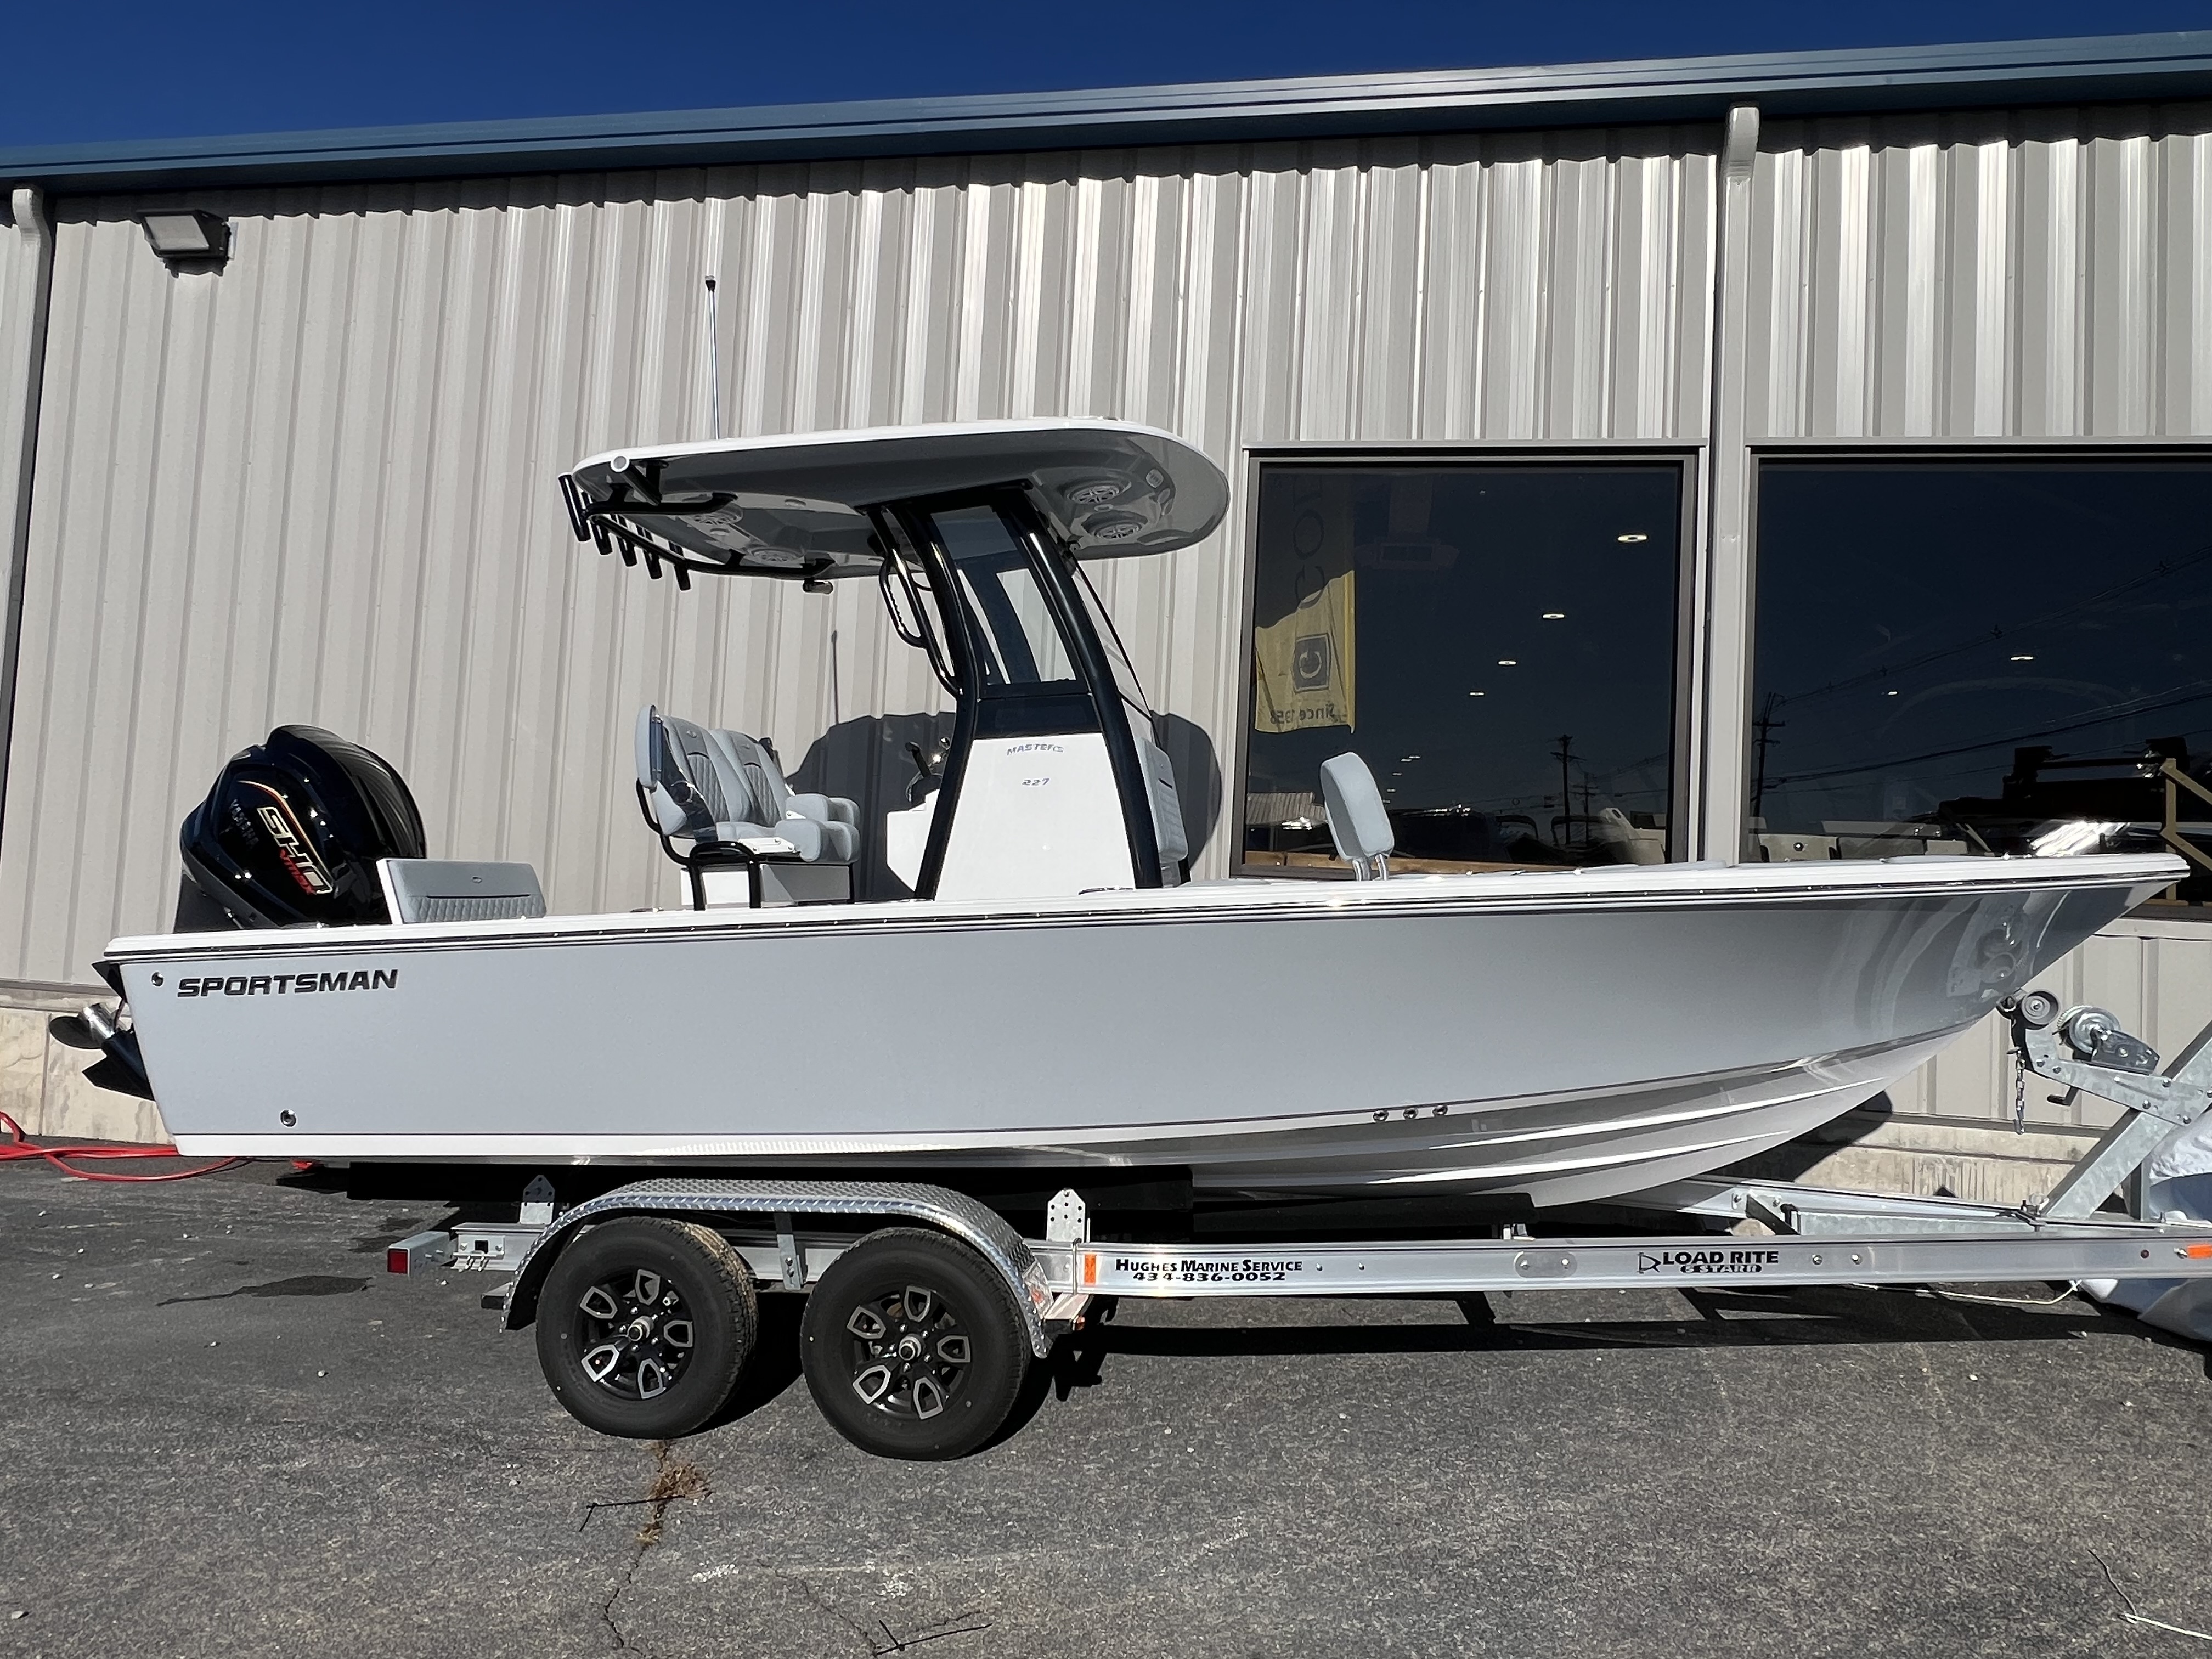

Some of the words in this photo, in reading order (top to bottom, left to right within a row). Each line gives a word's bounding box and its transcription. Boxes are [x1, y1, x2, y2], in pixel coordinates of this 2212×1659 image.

[256, 806, 332, 894] SHO
[177, 969, 398, 997] SPORTSMAN
[1662, 1251, 1724, 1265] LOAD
[1730, 1251, 1779, 1264] RITE
[1132, 1272, 1286, 1282] 434-836-0052
